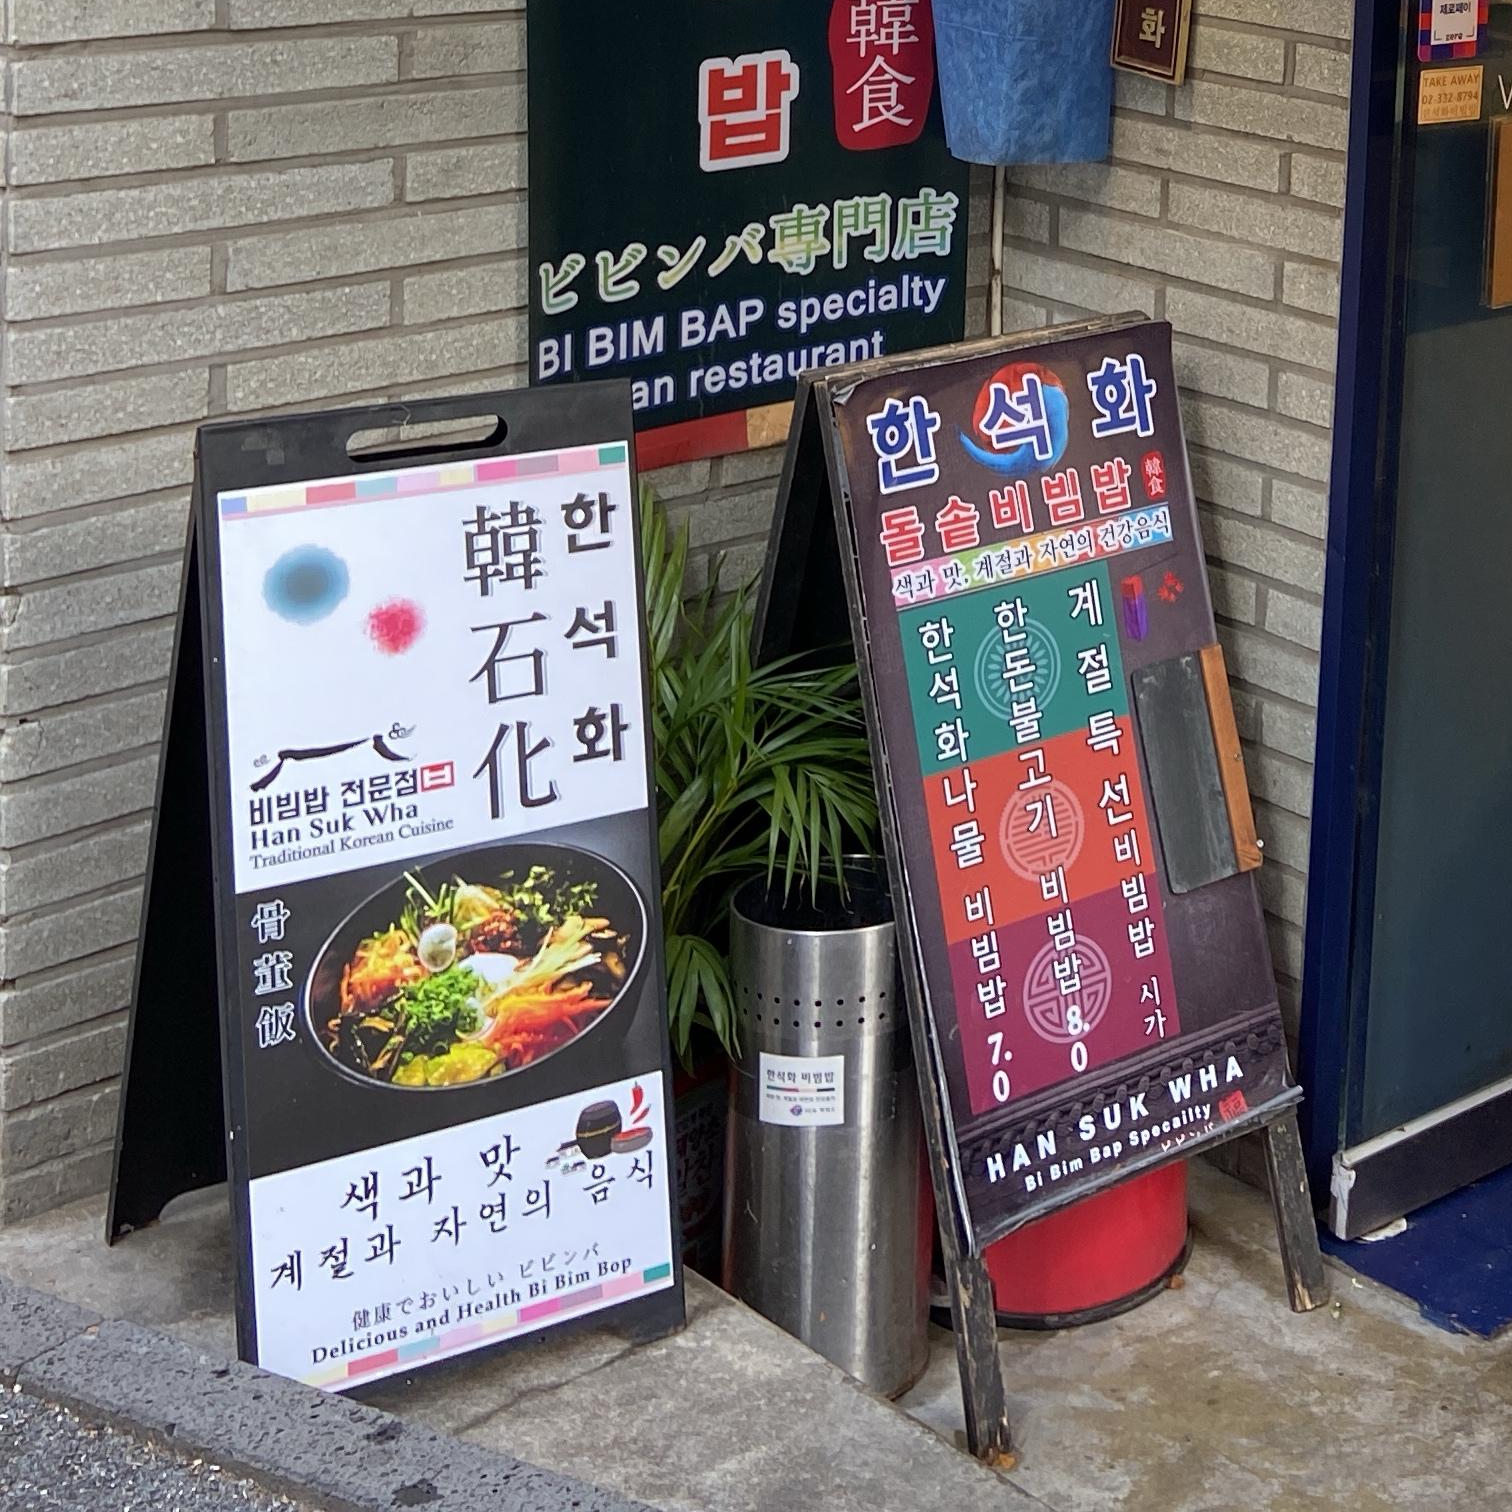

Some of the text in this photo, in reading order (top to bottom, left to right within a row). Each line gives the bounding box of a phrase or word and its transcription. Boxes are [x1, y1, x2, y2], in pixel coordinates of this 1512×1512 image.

[1422, 71, 1480, 88] TAKE AWAY
[539, 188, 959, 315] ビビンバ専門店
[538, 273, 948, 380] BI BIM BAP specialty
[690, 329, 885, 398] restaurant
[866, 353, 1157, 494] 한석화
[894, 569, 936, 600] 색과
[975, 548, 1033, 580] 계절과
[1040, 529, 1094, 564] 자연의
[1099, 510, 1171, 548] 건강음식
[462, 499, 558, 820] 韓石化
[560, 492, 629, 763] 한석화
[249, 768, 418, 827] 비빔밥 전문점
[249, 818, 455, 870] Traditional Korean Cuisine
[251, 801, 418, 850] Han Suk Wha
[986, 1055, 1245, 1184] HAN SUK WHA
[1024, 1172, 1044, 1193] Bi
[1050, 1157, 1084, 1182] Bim
[1090, 1140, 1122, 1165] Bap
[270, 1150, 655, 1291] 계절과 자연의 음식
[340, 1134, 522, 1222] 색과 맛
[311, 1258, 632, 1365] Delicious and Health Bi Bim Bop
